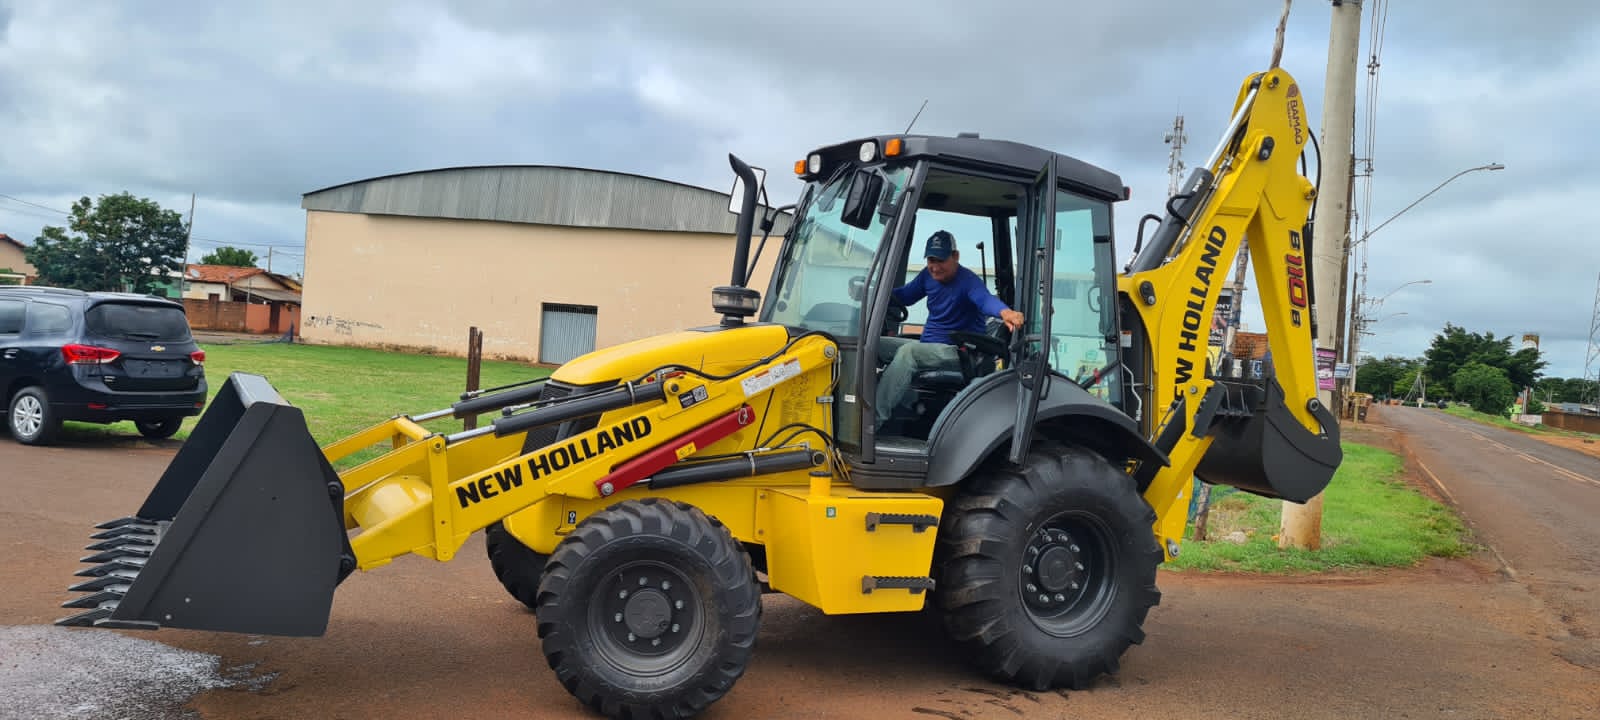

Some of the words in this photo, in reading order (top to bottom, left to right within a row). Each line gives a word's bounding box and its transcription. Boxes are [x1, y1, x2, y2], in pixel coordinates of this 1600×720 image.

[1178, 225, 1227, 352] HOLLAND
[1174, 357, 1193, 401] EW
[456, 464, 523, 508] NEW
[529, 416, 651, 480] HOLLAND
